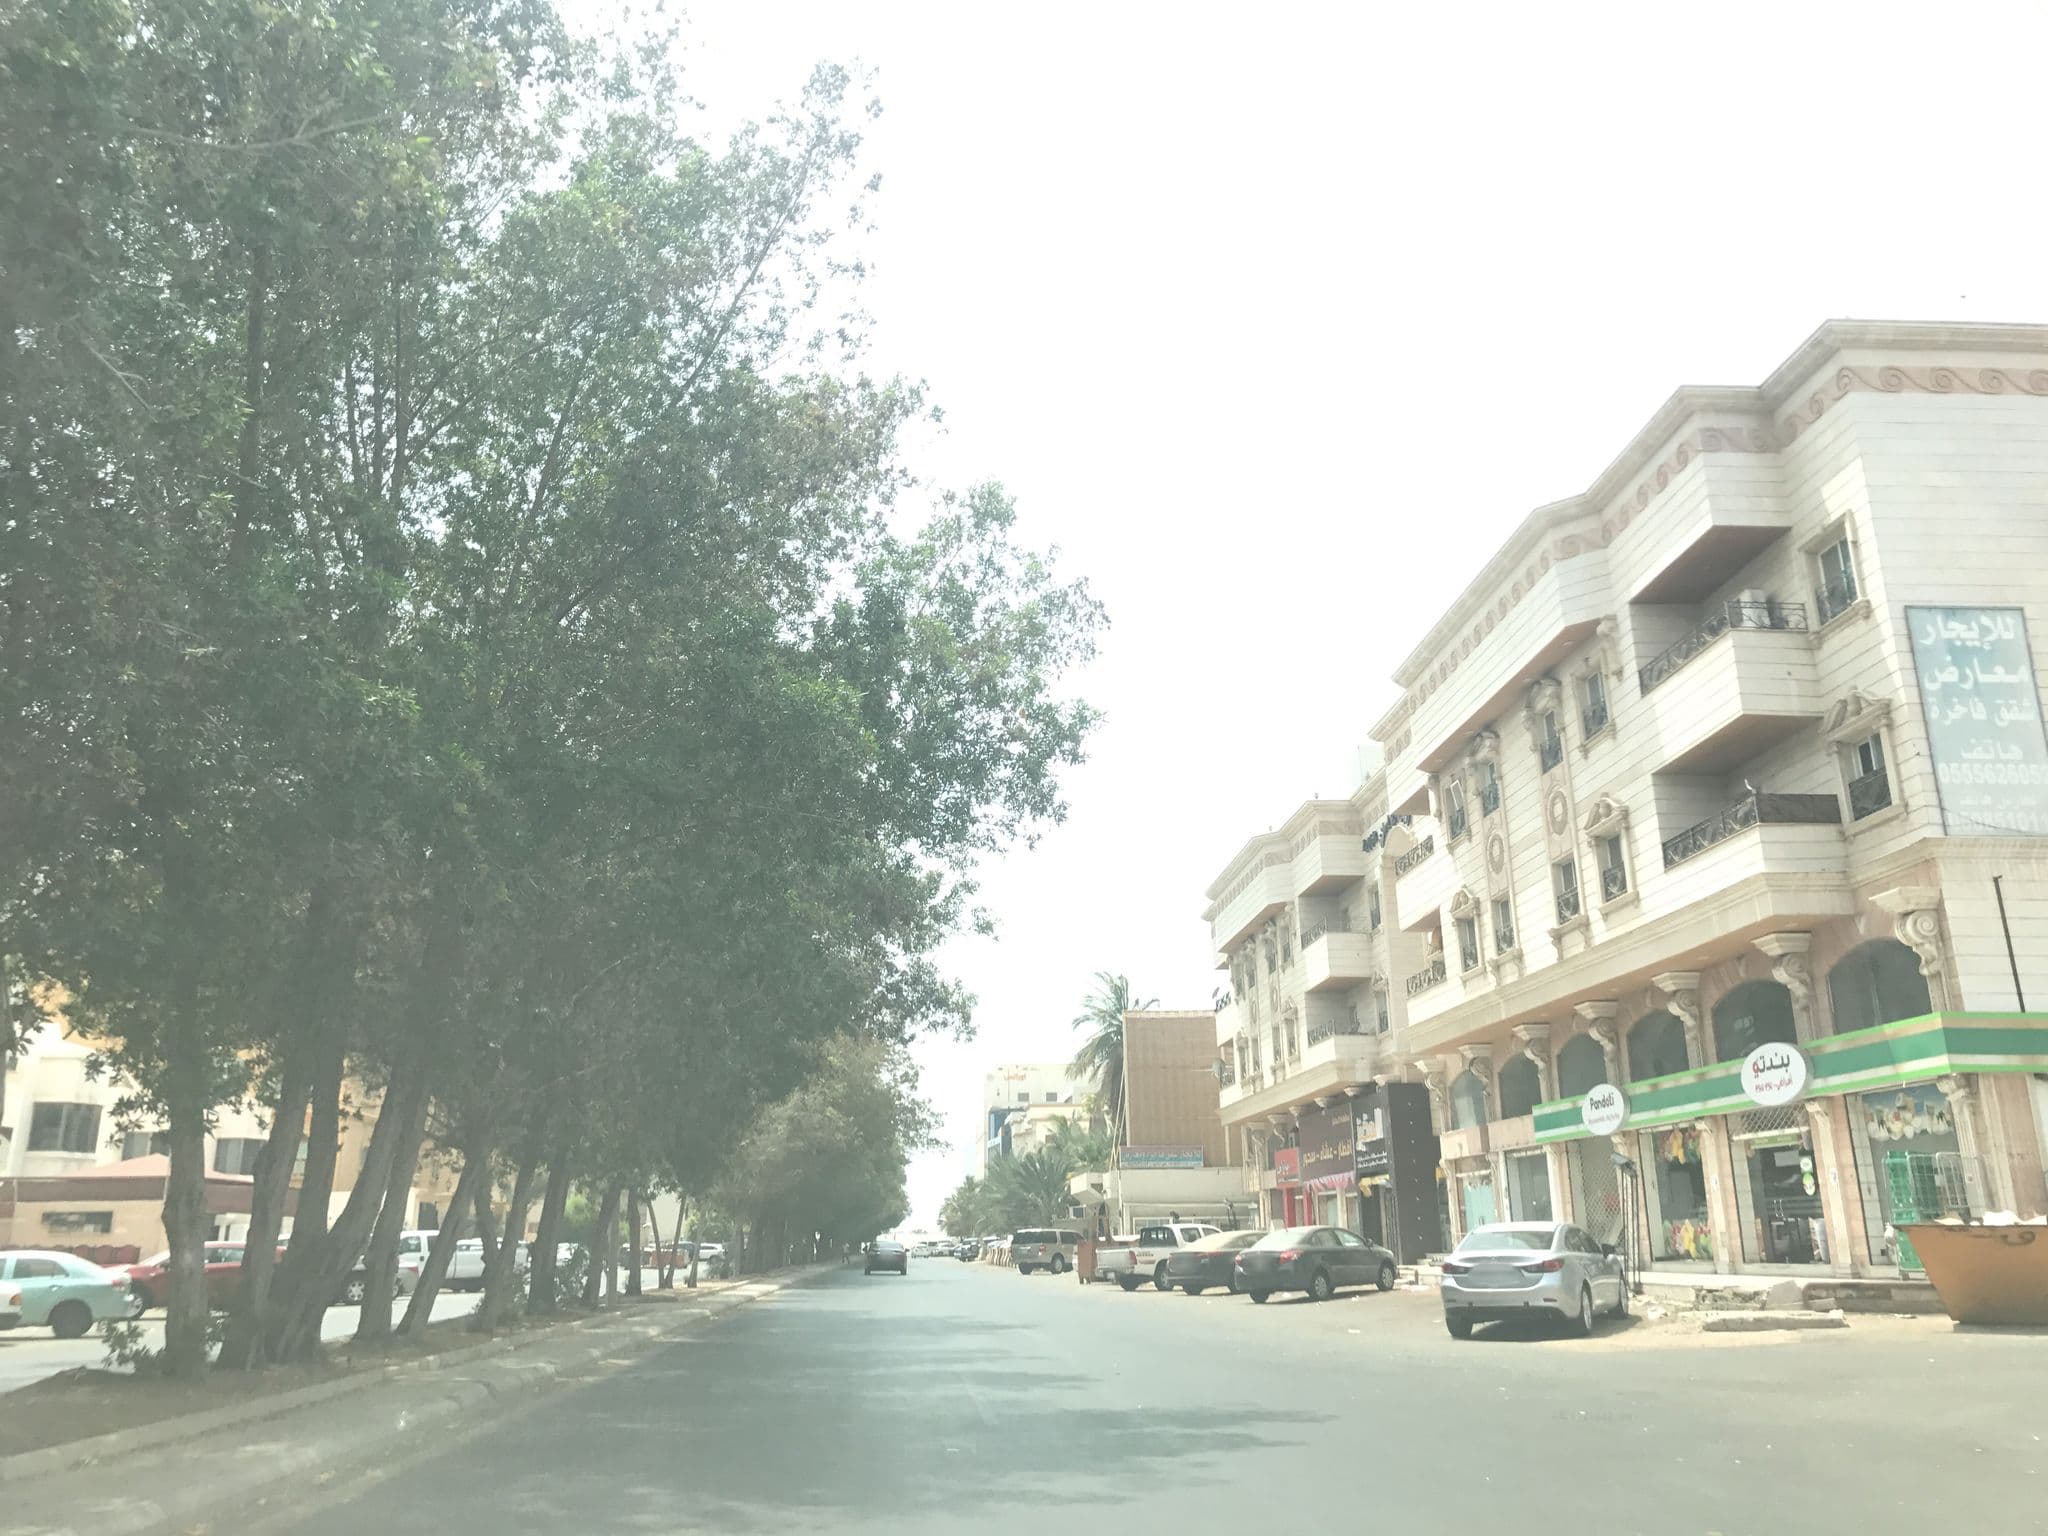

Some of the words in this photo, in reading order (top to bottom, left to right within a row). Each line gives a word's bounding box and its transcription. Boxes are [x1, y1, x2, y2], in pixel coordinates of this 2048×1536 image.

[1924, 655, 2029, 690] معارض
[1929, 696, 1988, 725] فاخرة
[1994, 697, 2037, 726] شقق
[1959, 739, 2024, 761] هاتف
